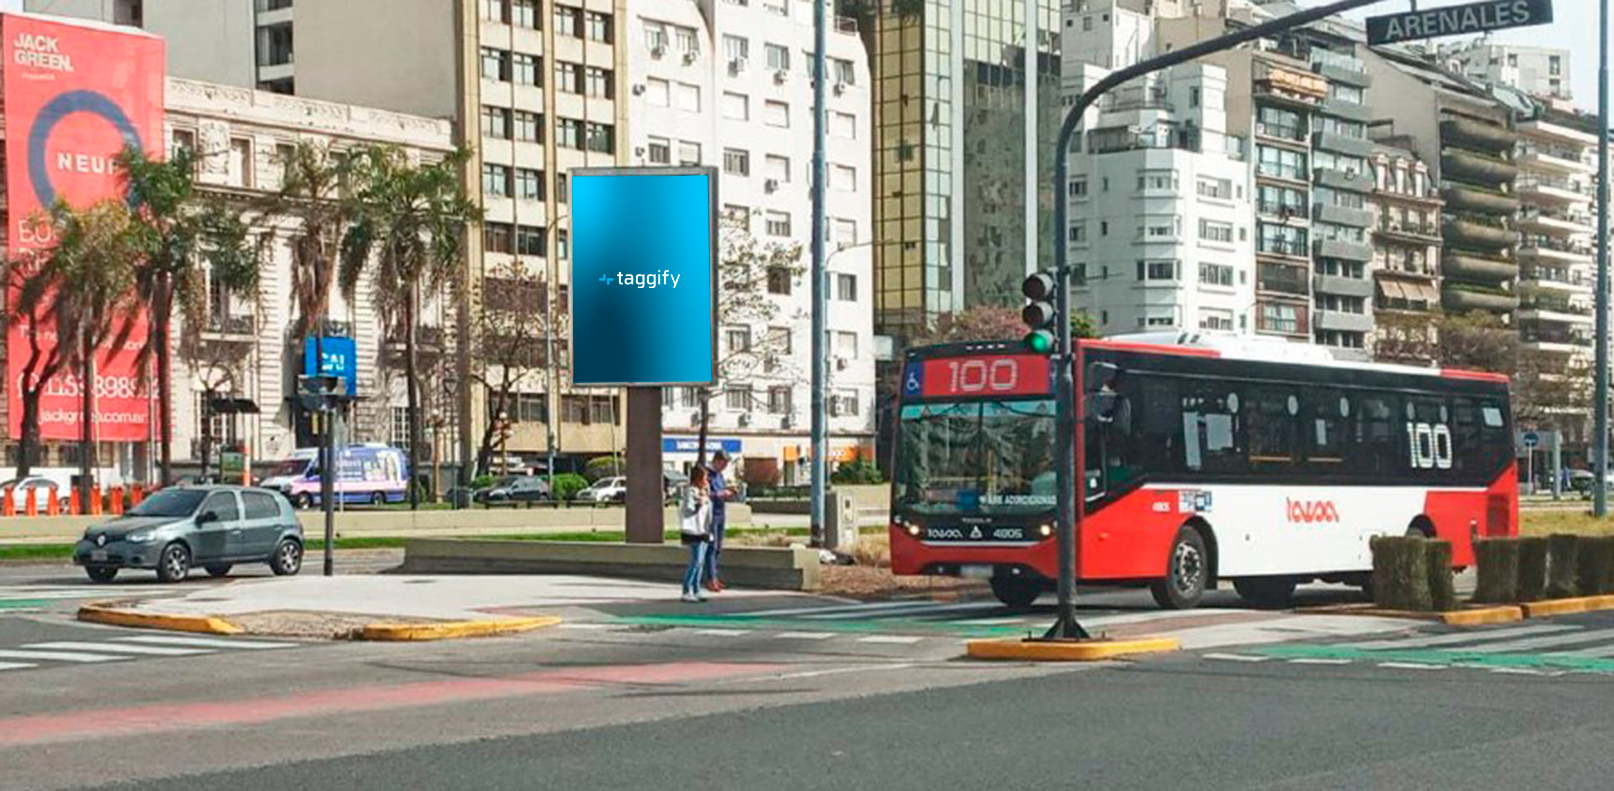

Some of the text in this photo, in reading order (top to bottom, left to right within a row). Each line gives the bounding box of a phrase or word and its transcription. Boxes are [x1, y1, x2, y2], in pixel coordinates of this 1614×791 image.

[1386, 2, 1530, 40] ARENALES
[14, 33, 59, 53] JACK
[14, 50, 74, 72] GREEN.
[616, 269, 681, 289] taggify
[949, 358, 1018, 392] 100
[1406, 422, 1453, 469] 100
